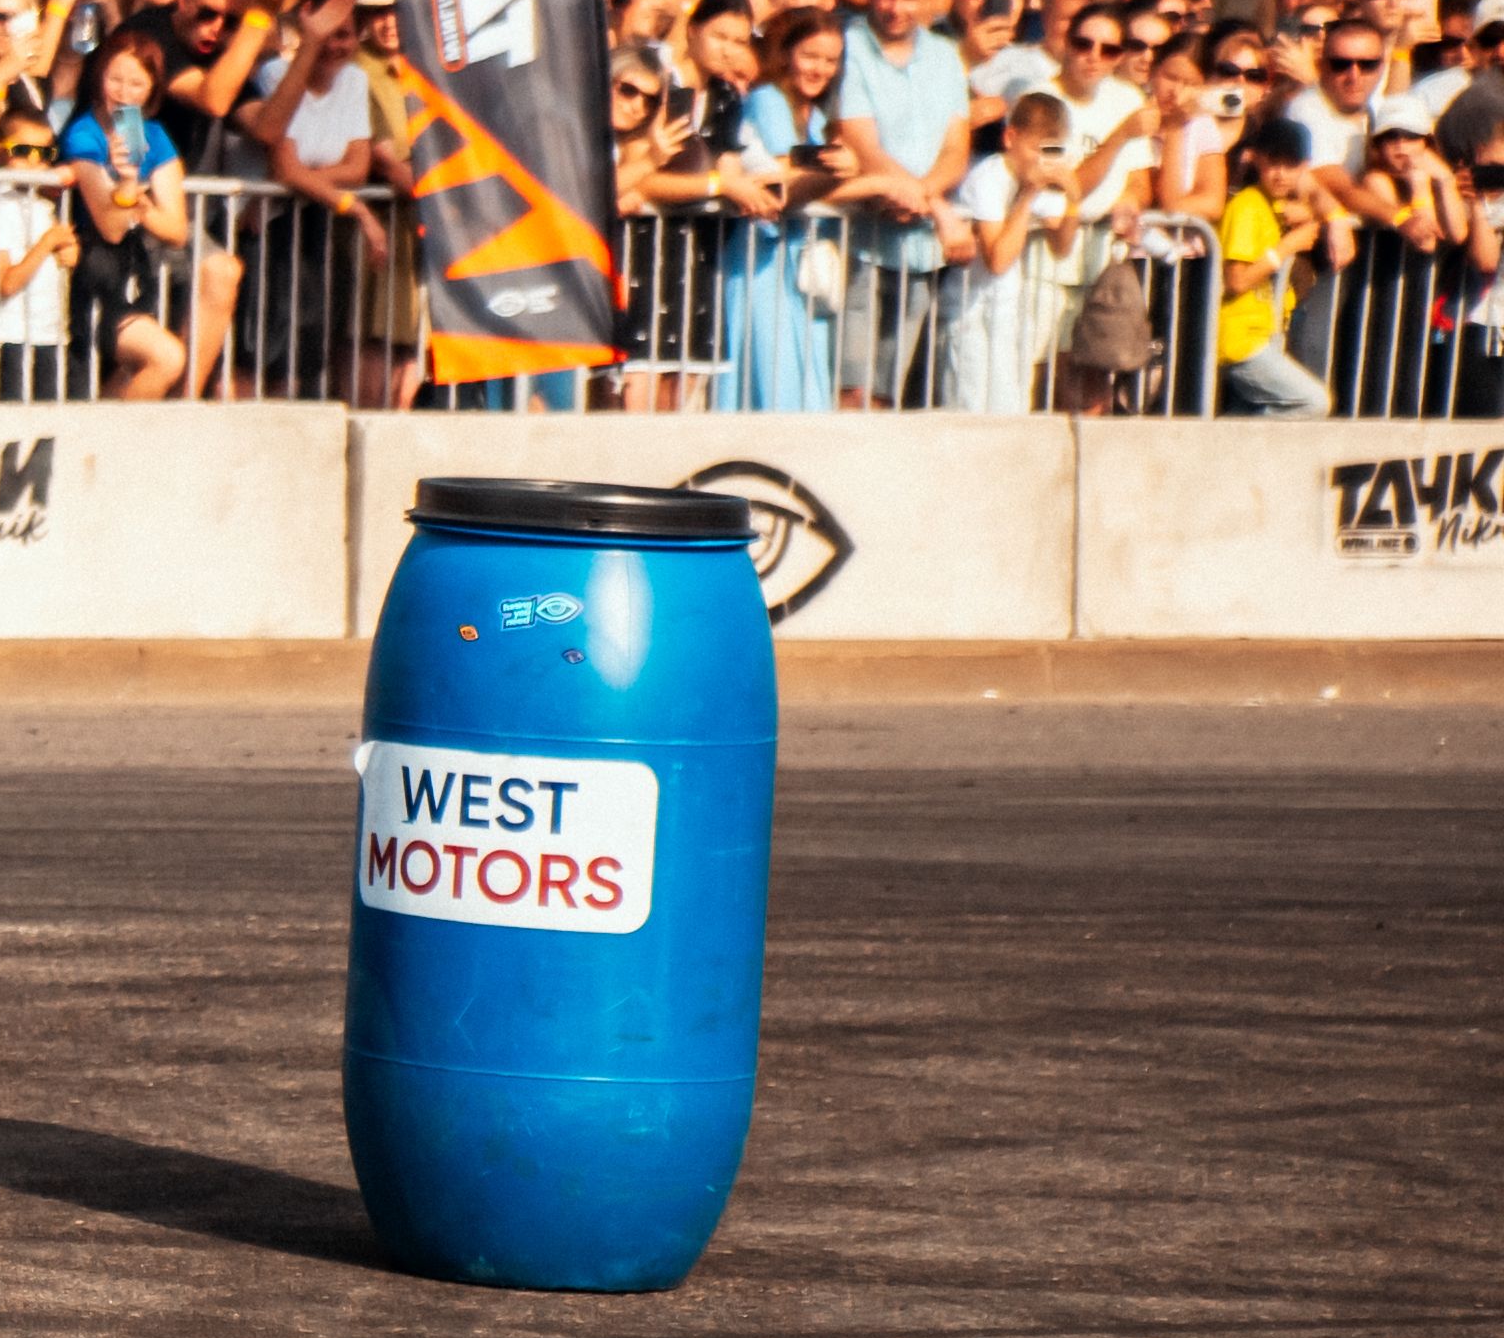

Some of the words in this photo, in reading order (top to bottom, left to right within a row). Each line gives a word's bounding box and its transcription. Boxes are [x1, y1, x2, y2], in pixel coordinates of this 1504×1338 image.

[1331, 448, 1504, 528] ТАЧК
[401, 765, 579, 835] WEST
[367, 832, 623, 911] MOTORS
